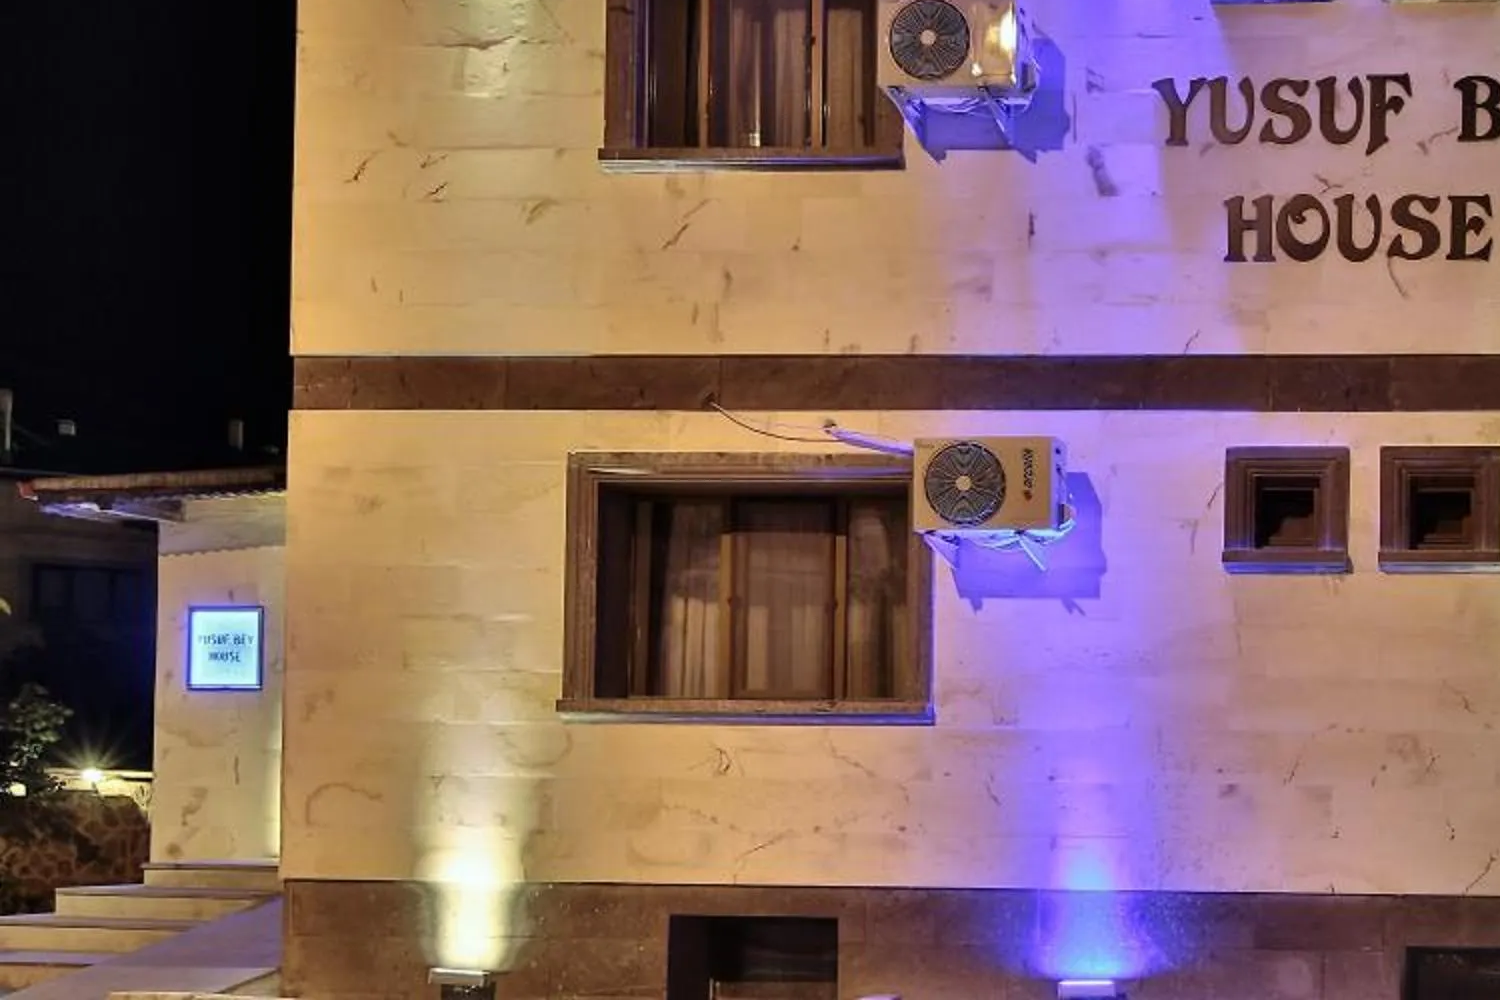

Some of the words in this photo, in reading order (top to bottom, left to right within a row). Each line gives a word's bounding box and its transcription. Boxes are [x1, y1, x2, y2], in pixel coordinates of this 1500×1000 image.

[1151, 73, 1412, 155] YUSUF
[1223, 194, 1494, 263] HOUSE
[208, 651, 241, 662] HOUSE
